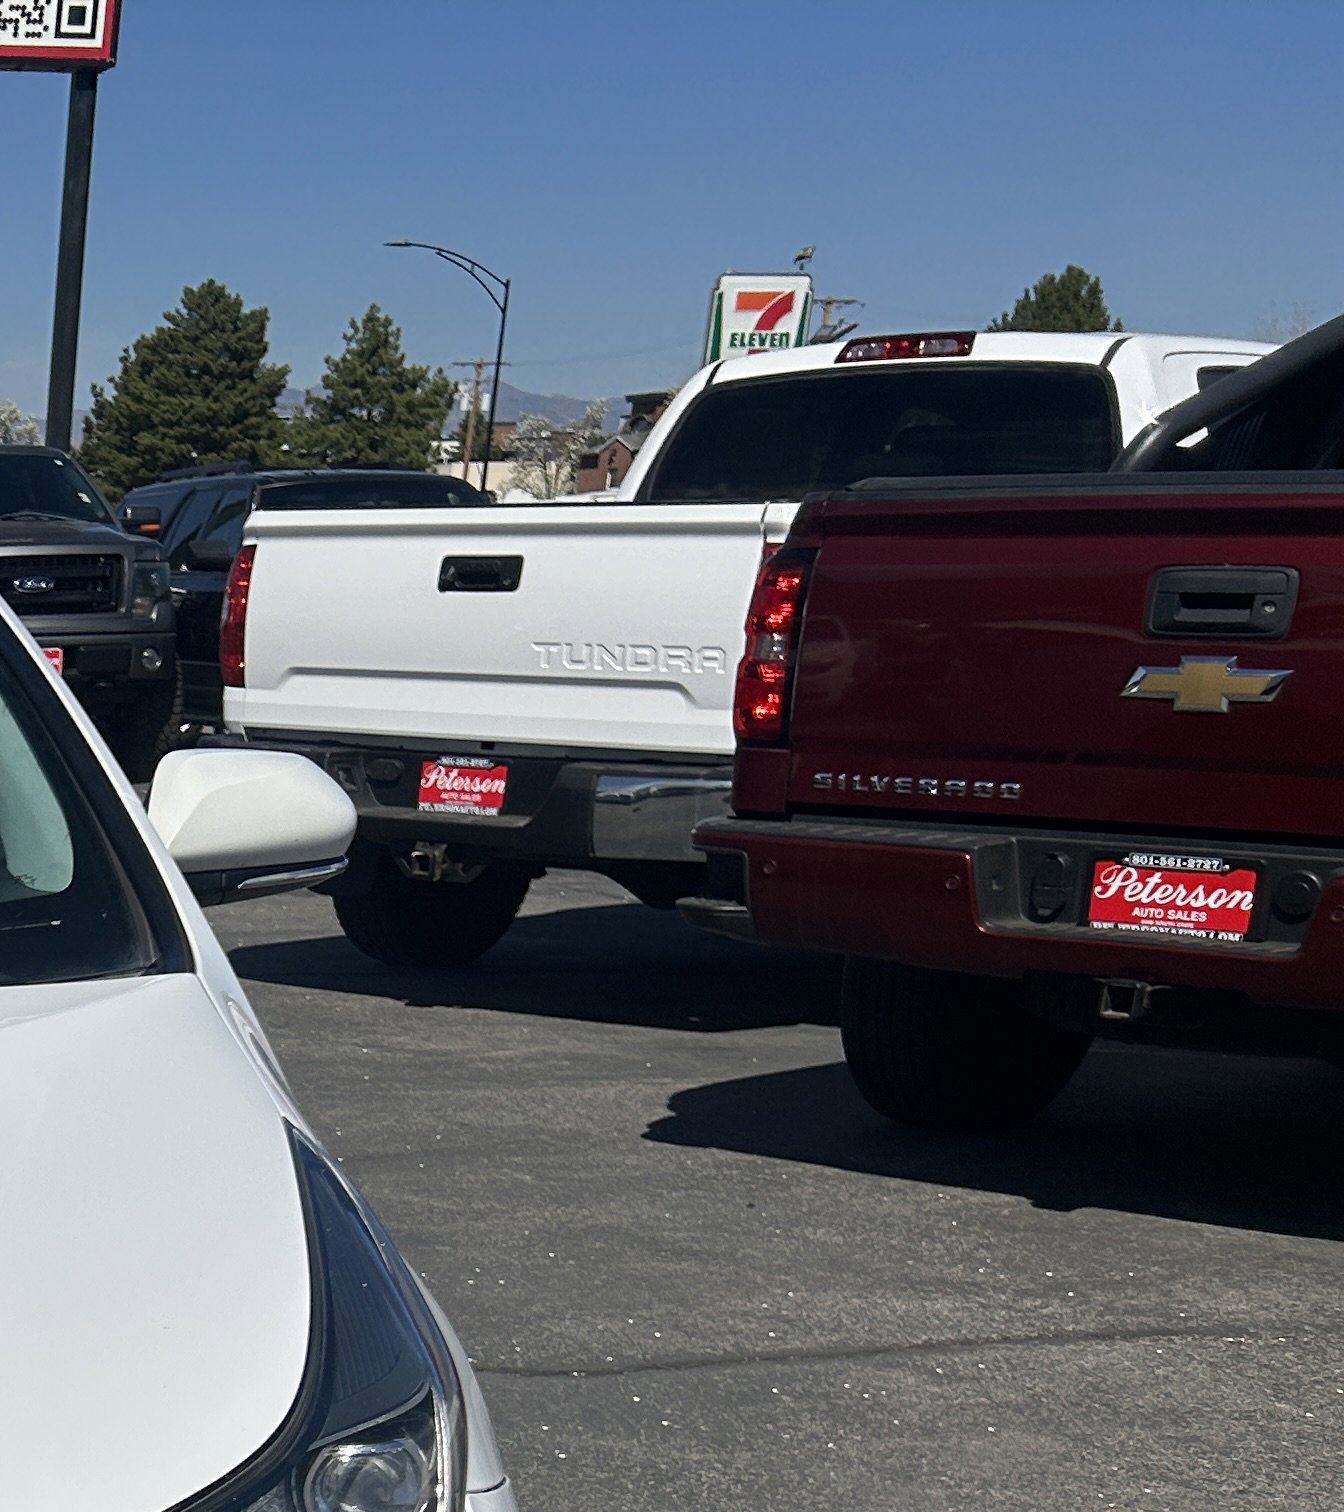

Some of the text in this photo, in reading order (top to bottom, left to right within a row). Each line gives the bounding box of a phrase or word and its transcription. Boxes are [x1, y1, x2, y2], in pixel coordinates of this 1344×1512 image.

[735, 289, 796, 352] 7
[531, 641, 727, 675] TUNDRA
[420, 763, 506, 794] Peterson
[813, 773, 1021, 800] SILVERADO
[1094, 864, 1254, 911] Peterson
[1132, 906, 1208, 922] AUTO SALES
